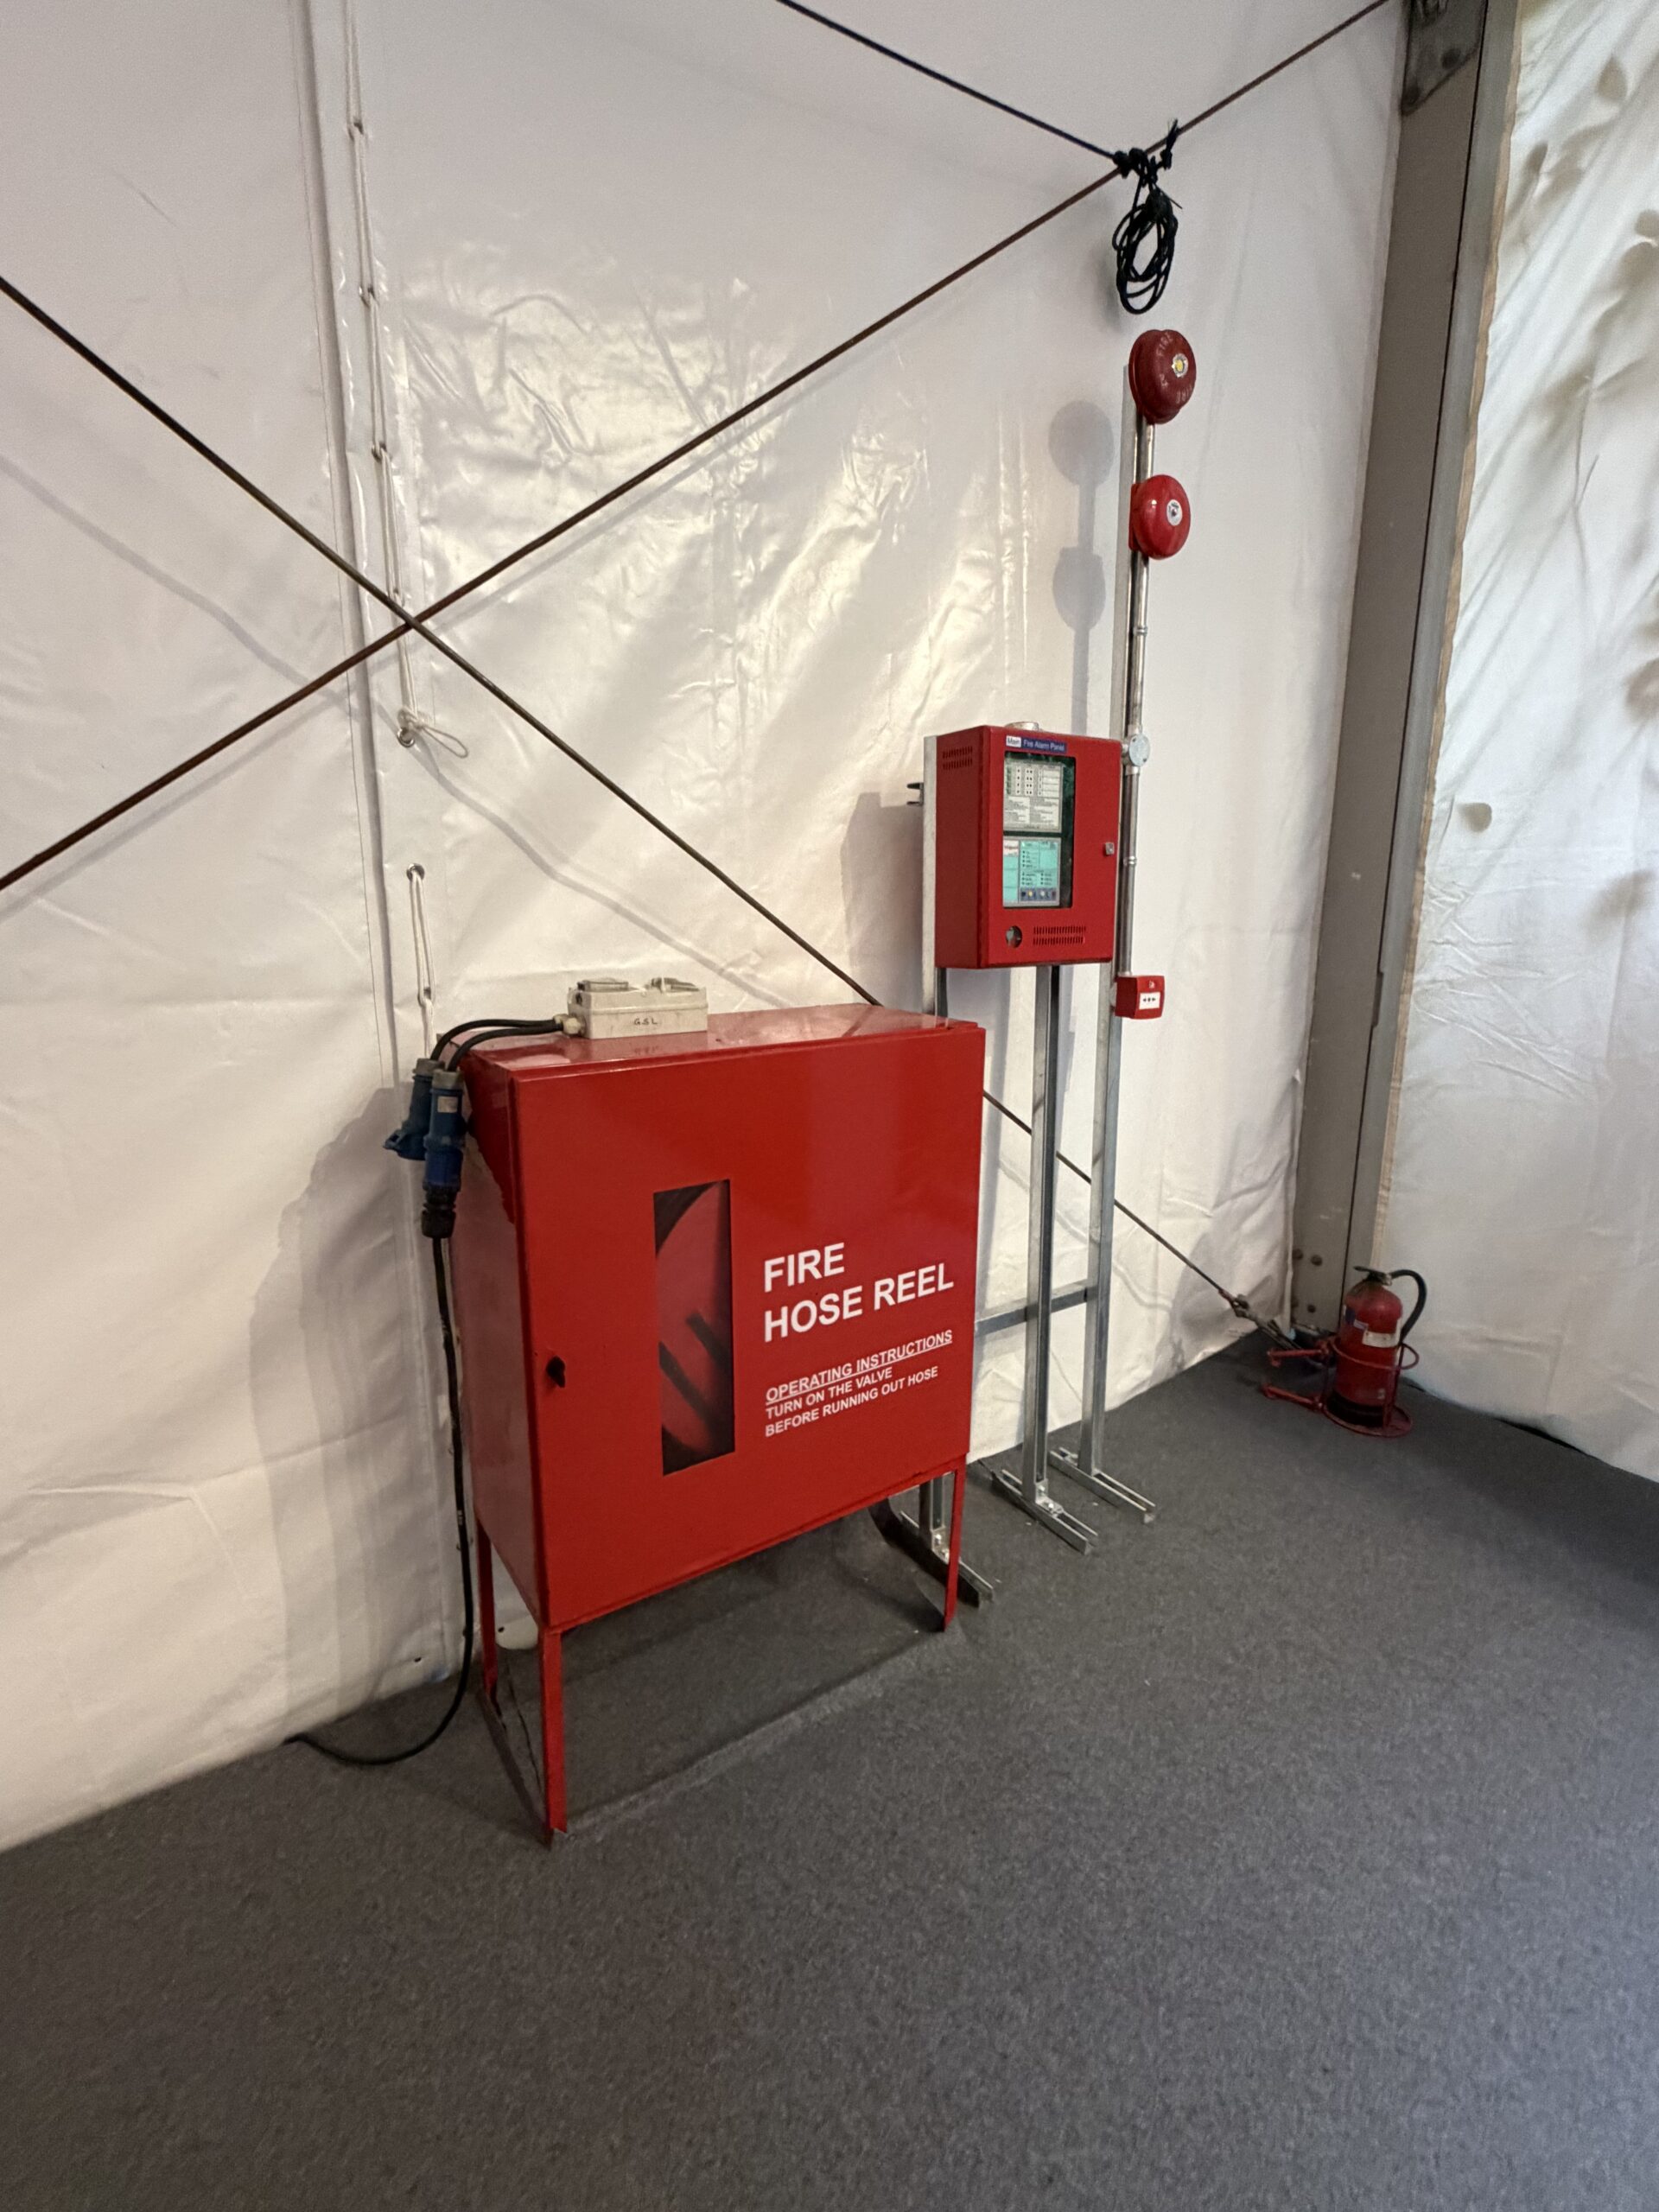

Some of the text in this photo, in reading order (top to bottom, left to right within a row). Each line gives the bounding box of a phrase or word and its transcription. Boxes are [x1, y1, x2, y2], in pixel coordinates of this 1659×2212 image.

[1023, 739, 1033, 747] Fire
[1034, 741, 1050, 750] Alarm
[1050, 741, 1065, 751] Panel
[765, 1242, 845, 1293] FIRE
[765, 1262, 954, 1343] HOSE REEL
[766, 1329, 952, 1403] OPERATING INSTRUCTIONS
[766, 1366, 893, 1420] TURN ON THE VALVE
[766, 1365, 938, 1437] BEFORE RUNNING OUT HOSE
